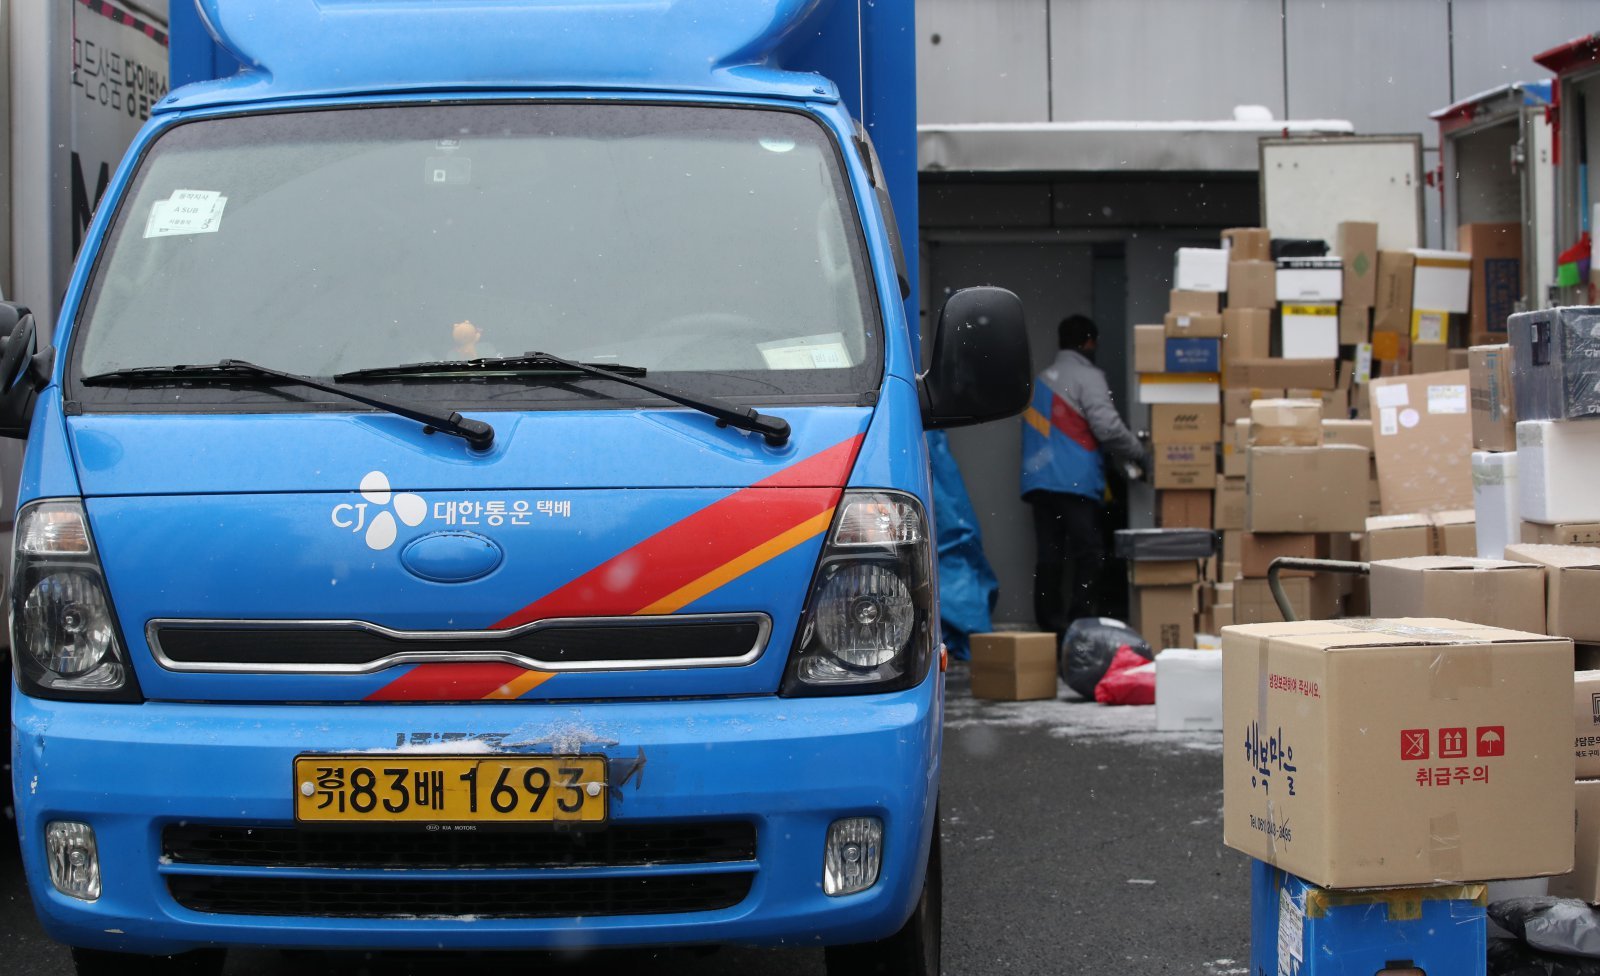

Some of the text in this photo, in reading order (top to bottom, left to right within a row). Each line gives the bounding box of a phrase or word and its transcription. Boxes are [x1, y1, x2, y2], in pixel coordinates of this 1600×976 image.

[331, 503, 368, 533] CJ
[433, 500, 571, 526] 대한통운 택배
[1269, 673, 1321, 699] 냉장보관하여 주십시오.
[1244, 720, 1297, 796] 행복마을
[316, 767, 585, 813] 경기 83배 1693
[1415, 765, 1490, 787] 취급주의
